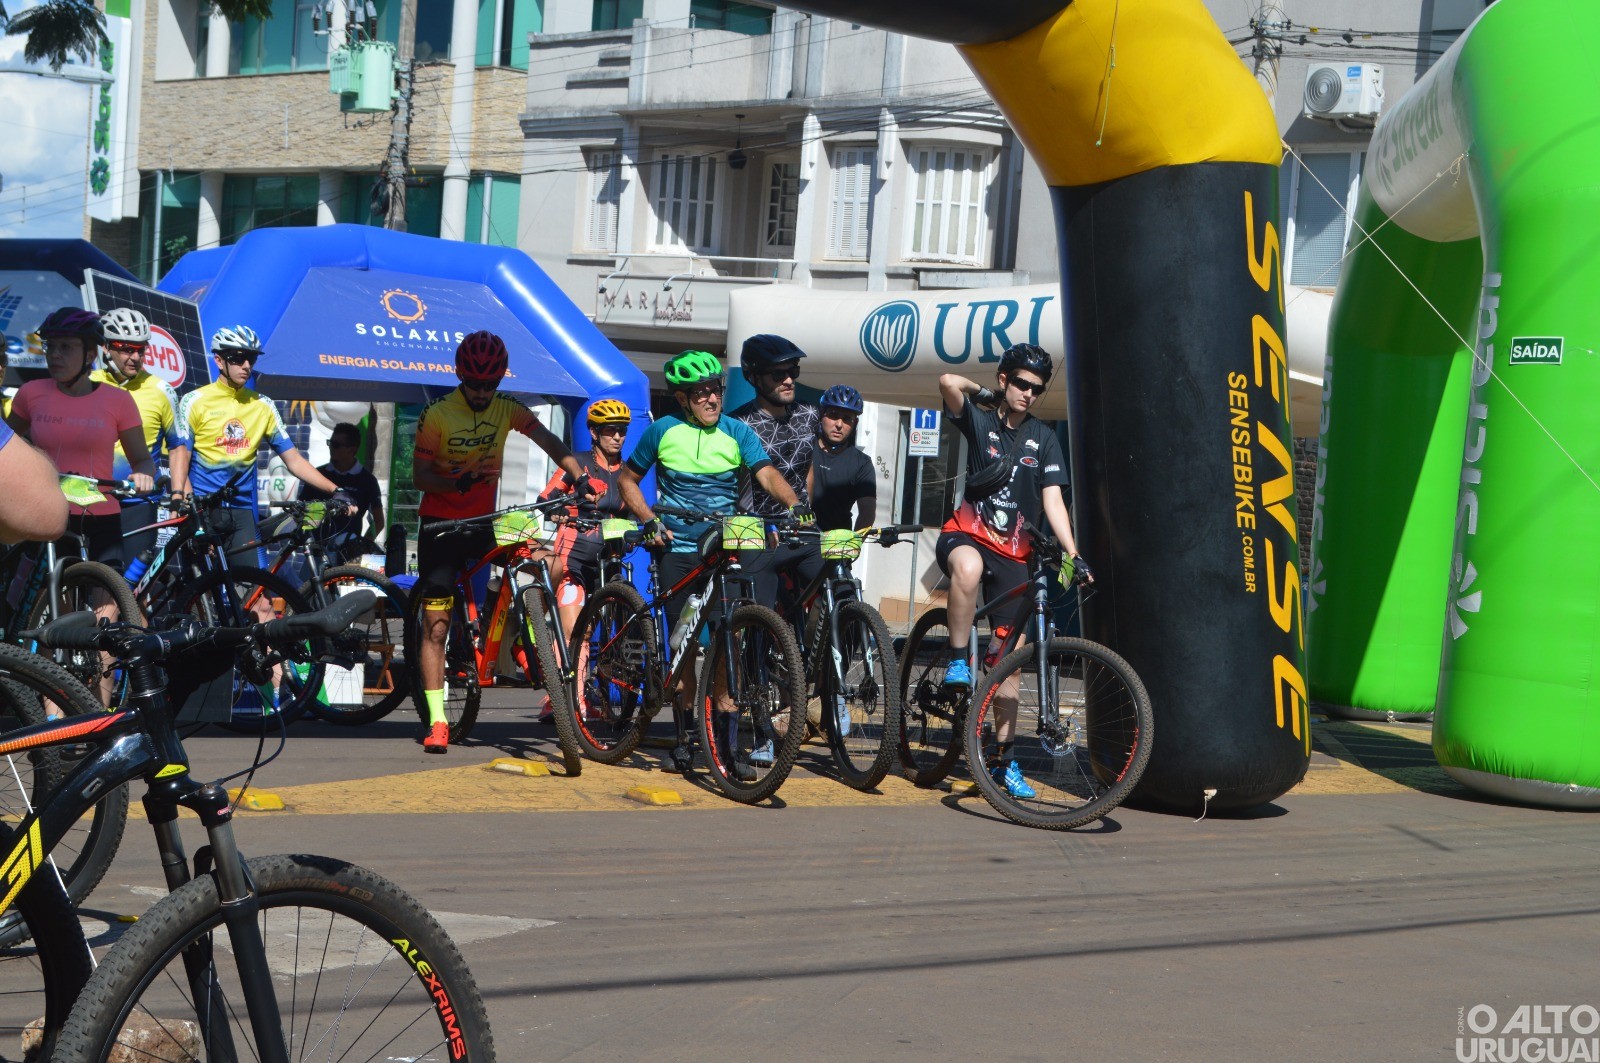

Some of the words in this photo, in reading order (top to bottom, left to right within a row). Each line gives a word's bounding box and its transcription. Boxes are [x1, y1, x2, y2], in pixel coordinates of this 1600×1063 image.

[603, 289, 694, 312] MARIAH
[355, 322, 464, 343] SOLAXIS
[934, 295, 1055, 365] URI
[1512, 342, 1560, 359] SAÍDA
[319, 353, 379, 369] ENERGIA
[380, 358, 426, 372] SOLAR
[876, 456, 889, 479] 936
[391, 938, 466, 1060] ALEXRIMS
